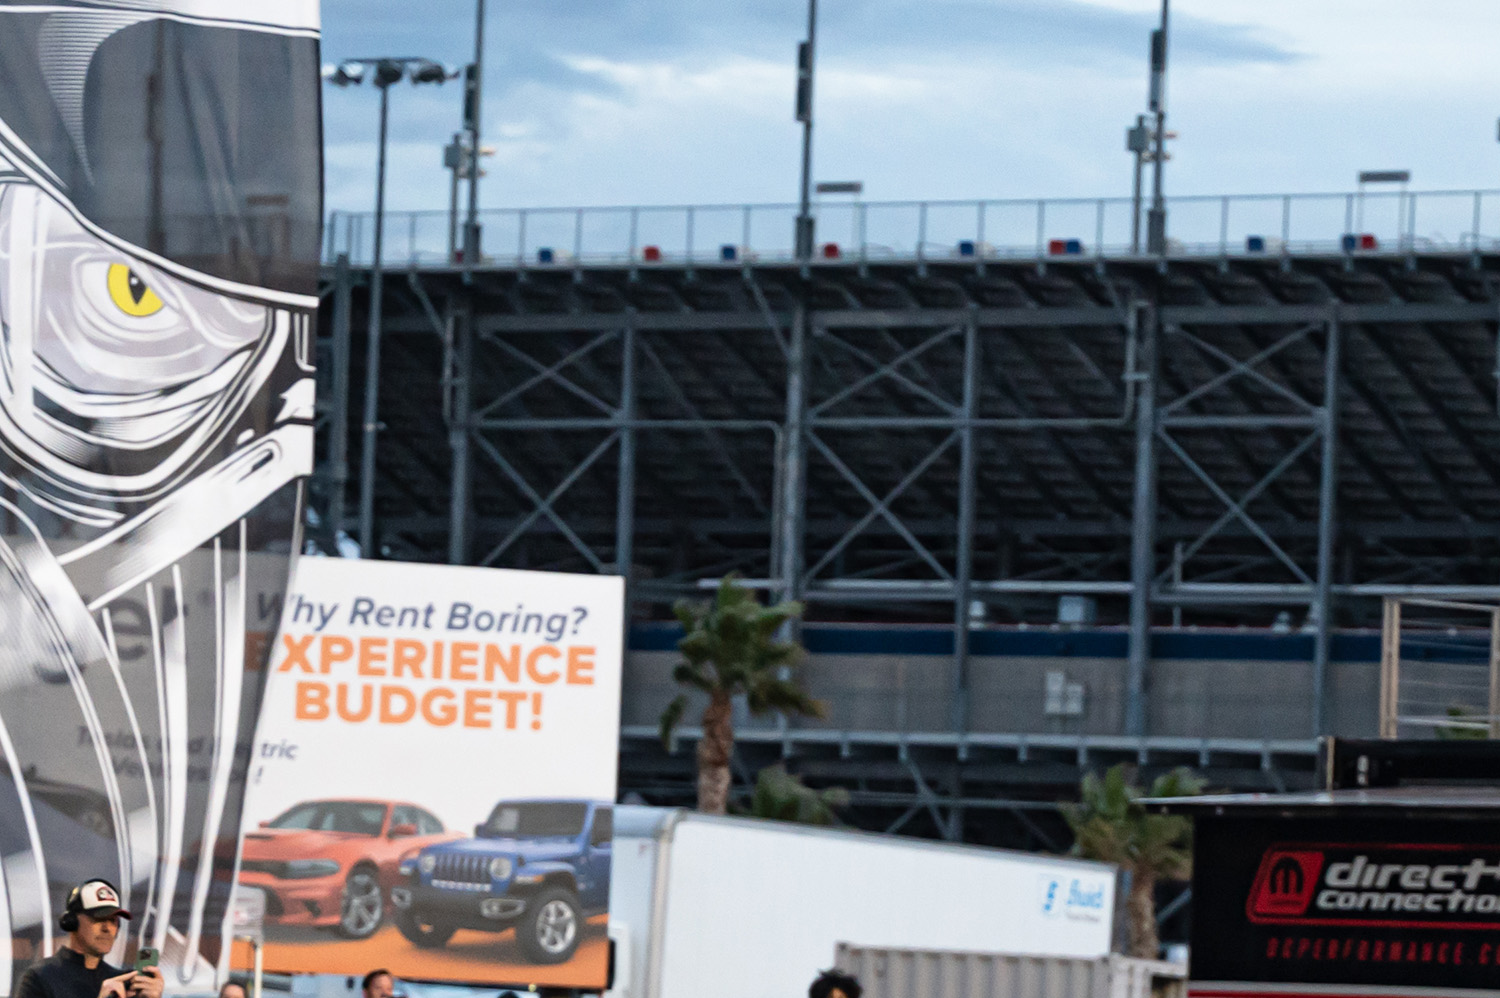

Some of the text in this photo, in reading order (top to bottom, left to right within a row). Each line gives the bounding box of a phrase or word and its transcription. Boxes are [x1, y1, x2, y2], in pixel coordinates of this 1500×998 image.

[350, 597, 436, 629] Rent
[446, 601, 588, 642] Boring?
[295, 681, 543, 731] BUDGET!
